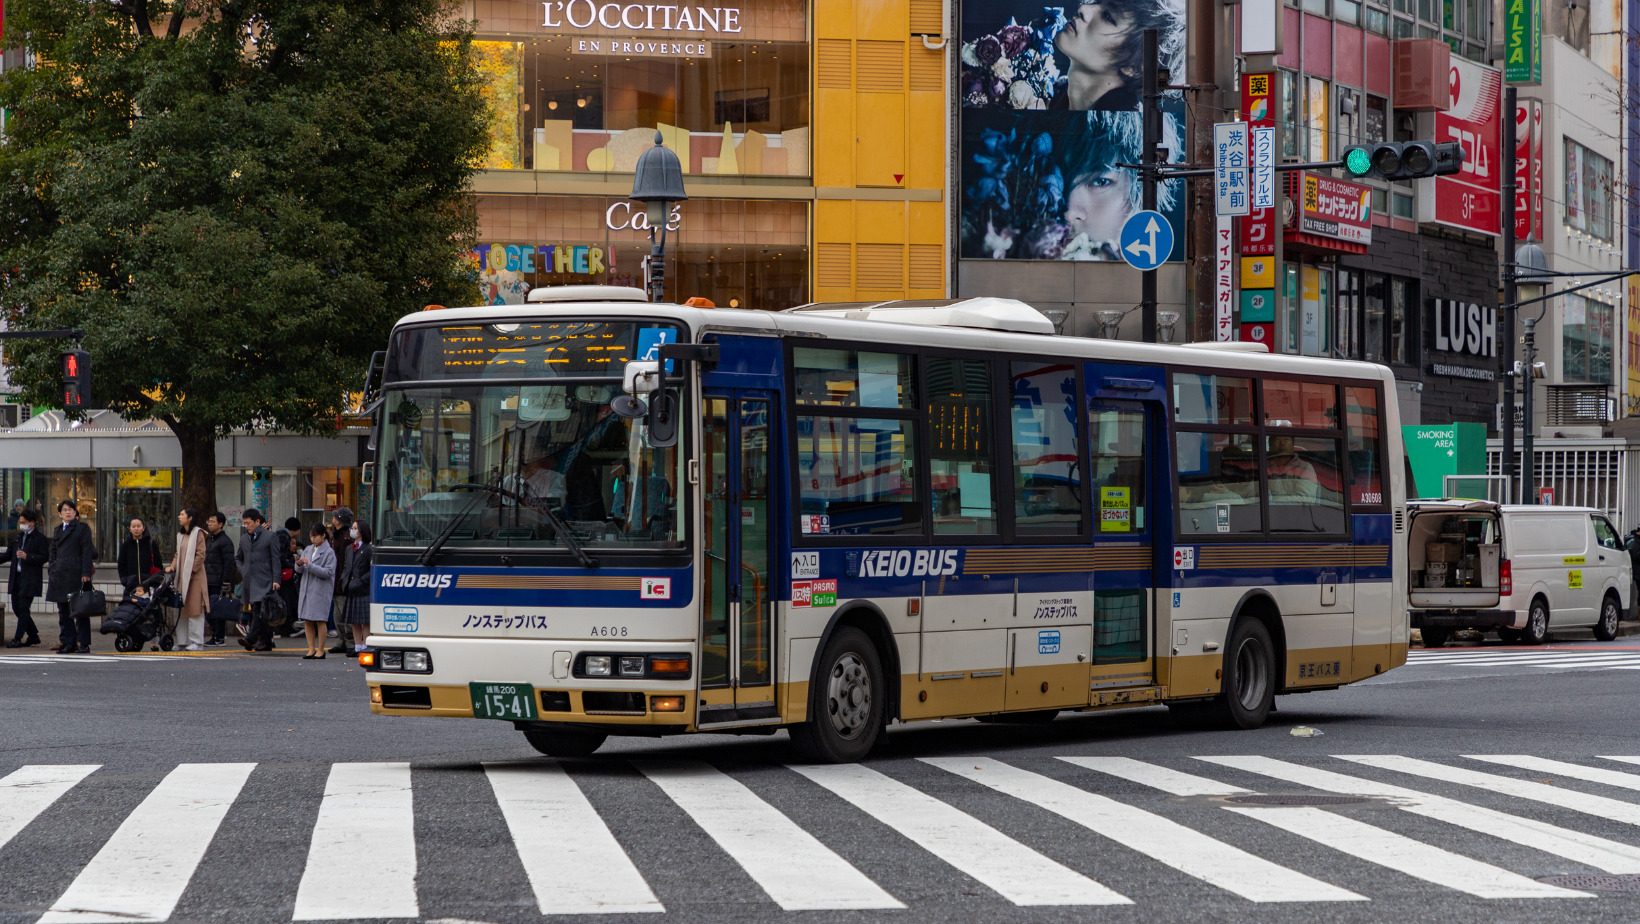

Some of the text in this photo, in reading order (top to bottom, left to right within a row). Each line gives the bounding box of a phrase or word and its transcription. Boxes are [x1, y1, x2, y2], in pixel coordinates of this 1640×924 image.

[541, 0, 742, 33] L'OCCITANE
[579, 40, 706, 55] EN PROVENCE
[1250, 77, 1267, 94] 薬
[1219, 143, 1228, 199] Shibuya Sta.
[1228, 130, 1245, 208] 渋谷駅前
[1258, 131, 1270, 205] スクランブル式
[1305, 180, 1317, 208] 薬
[1319, 179, 1332, 193] DRUG
[1336, 183, 1360, 198] COSMETIC
[1318, 193, 1359, 220] サンドラッグ
[1461, 192, 1475, 220] 3F
[606, 201, 682, 239] Caé
[1304, 218, 1338, 234] TAX FREE SHOP
[1253, 264, 1264, 273] 3F
[1219, 229, 1231, 341] マイアミガーデン
[1252, 297, 1264, 307] 2F
[1253, 327, 1263, 337] 1F
[1435, 298, 1497, 358] LUSH
[1417, 430, 1454, 439] SMOKING
[1434, 439, 1454, 448] AREA
[1102, 510, 1129, 520] 近づかないで
[802, 555, 817, 566] 入口
[1182, 549, 1193, 560] 出口
[859, 549, 958, 578] KEIO BUS
[800, 568, 819, 576] ENTRANCE
[381, 573, 453, 588] KEIO BUS
[813, 582, 835, 592] PASMO
[814, 595, 834, 605] Suica
[1033, 605, 1078, 619] ノンステップバス
[462, 614, 548, 629] ノンステップバス
[590, 626, 628, 637] A608
[1299, 662, 1340, 679] 京王バス東
[500, 686, 516, 694] 200
[484, 694, 531, 718] 15-41
